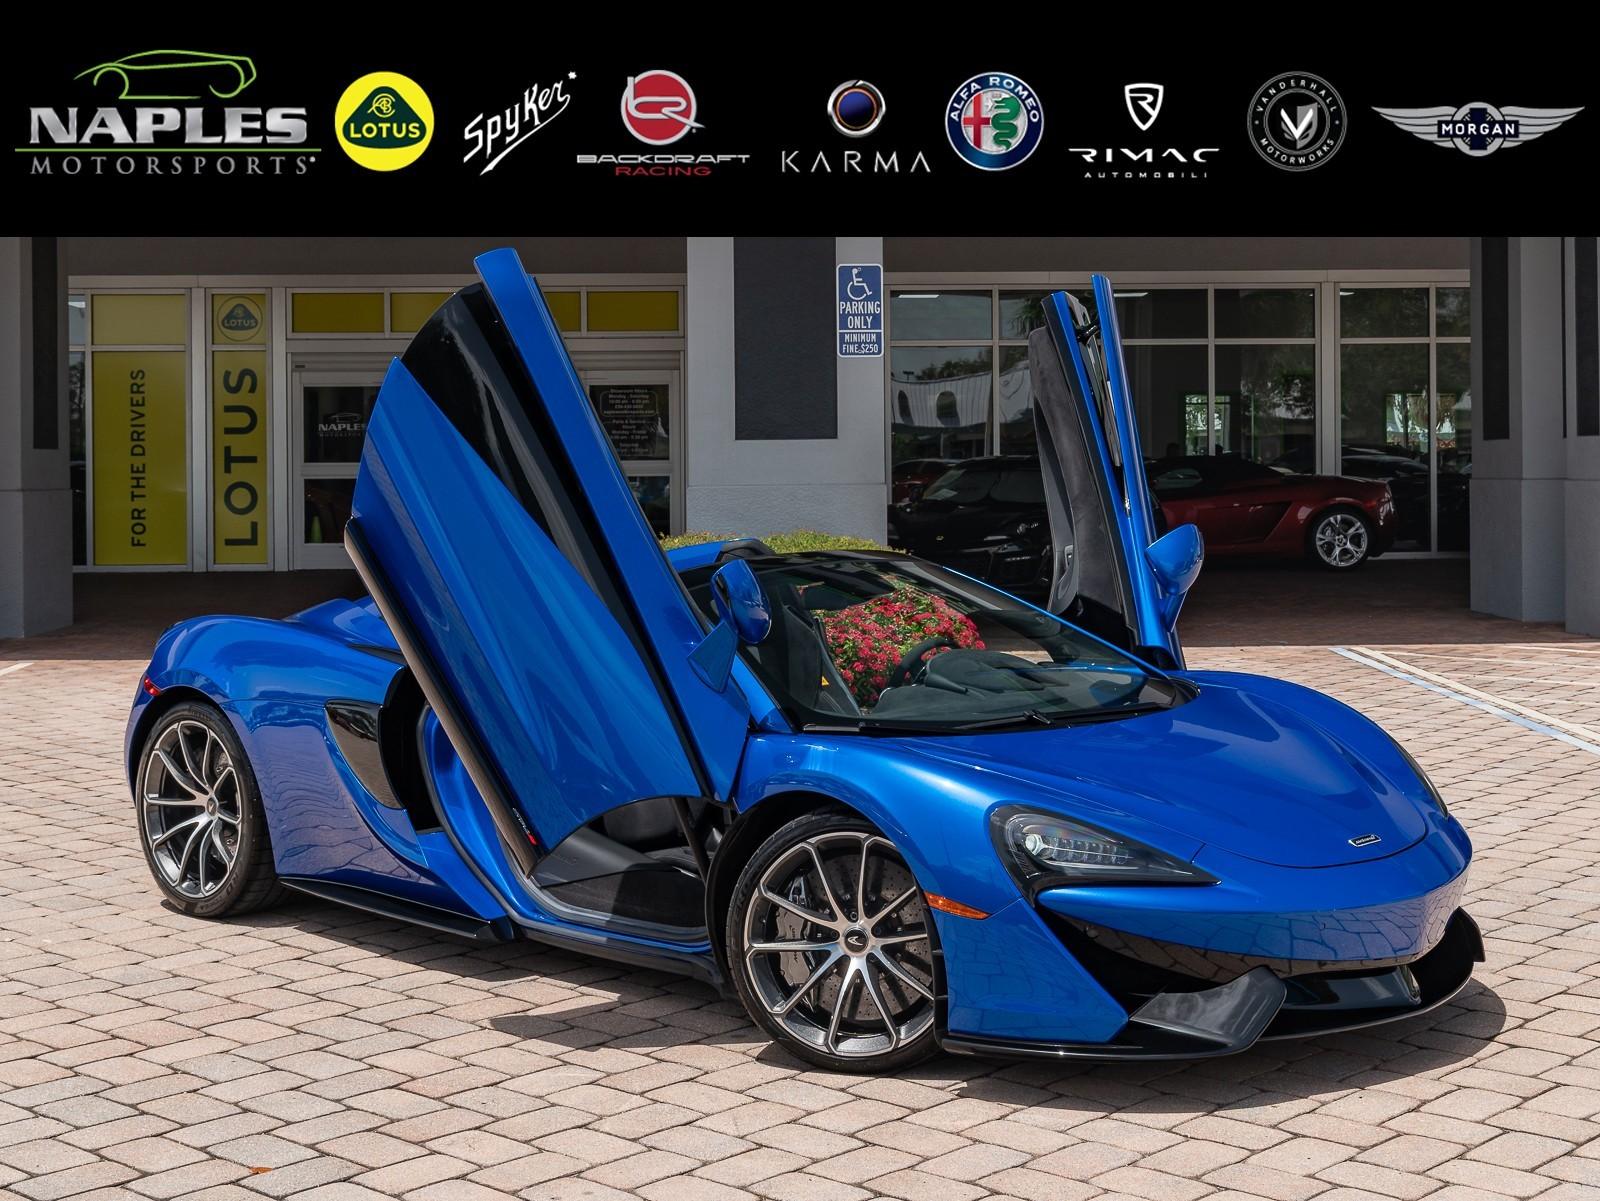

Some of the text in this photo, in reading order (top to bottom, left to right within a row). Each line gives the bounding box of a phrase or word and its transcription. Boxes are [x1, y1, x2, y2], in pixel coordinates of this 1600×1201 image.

[839, 301, 881, 314] PARKING
[224, 319, 257, 328] LOTUS
[847, 315, 873, 329] ONLY
[844, 333, 877, 343] MINIMUM
[842, 343, 879, 354] FINE $250
[130, 369, 147, 547] FOR THE DRIVERS
[223, 367, 259, 546] LOTUS
